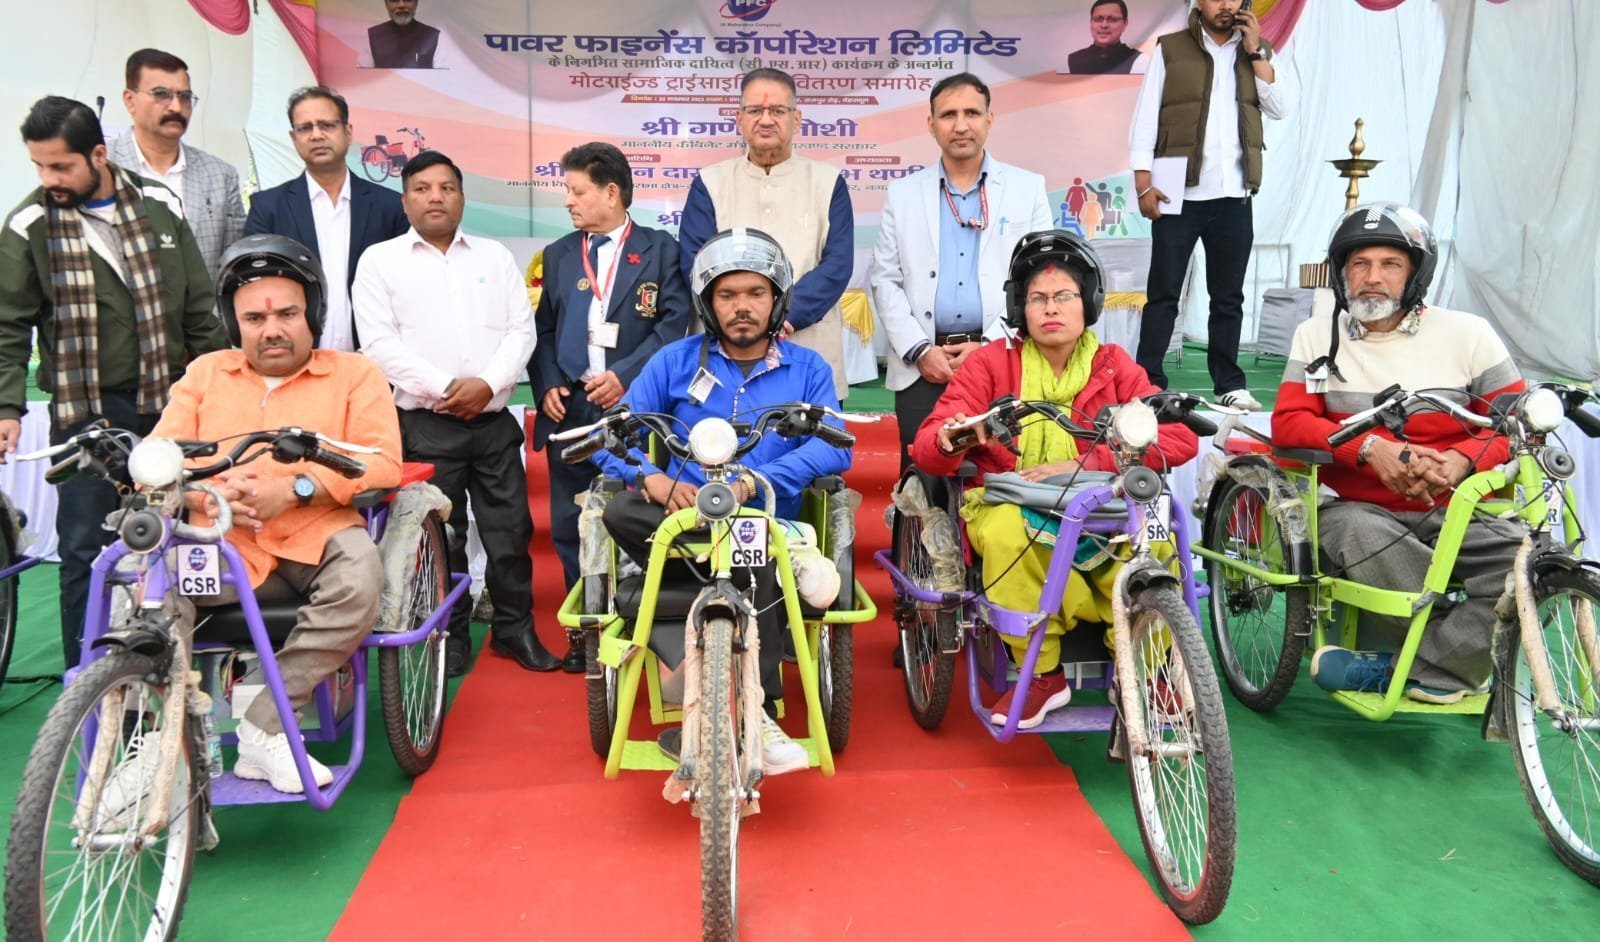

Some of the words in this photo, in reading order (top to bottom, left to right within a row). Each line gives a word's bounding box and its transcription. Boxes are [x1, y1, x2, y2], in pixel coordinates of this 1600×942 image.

[484, 34, 567, 52] पावर
[574, 29, 705, 56] फाइनेंस
[714, 30, 879, 55] कॉर्पोरेशन
[888, 29, 1021, 57] लिमिटेड
[549, 55, 561, 68] के
[565, 55, 618, 68] निगमित
[622, 56, 685, 69] सामाजिक
[689, 57, 734, 69] दायित्व
[832, 57, 884, 70] कार्यक्रम
[888, 58, 899, 70] के
[569, 72, 661, 91] मोटराईज्ड
[862, 74, 932, 91] समारोह
[641, 117, 681, 136] श्री
[688, 118, 742, 136] गणे
[534, 161, 565, 178] श्री
[1147, 524, 1166, 540] SR
[731, 549, 763, 565] CSR
[182, 577, 217, 594] CSR
